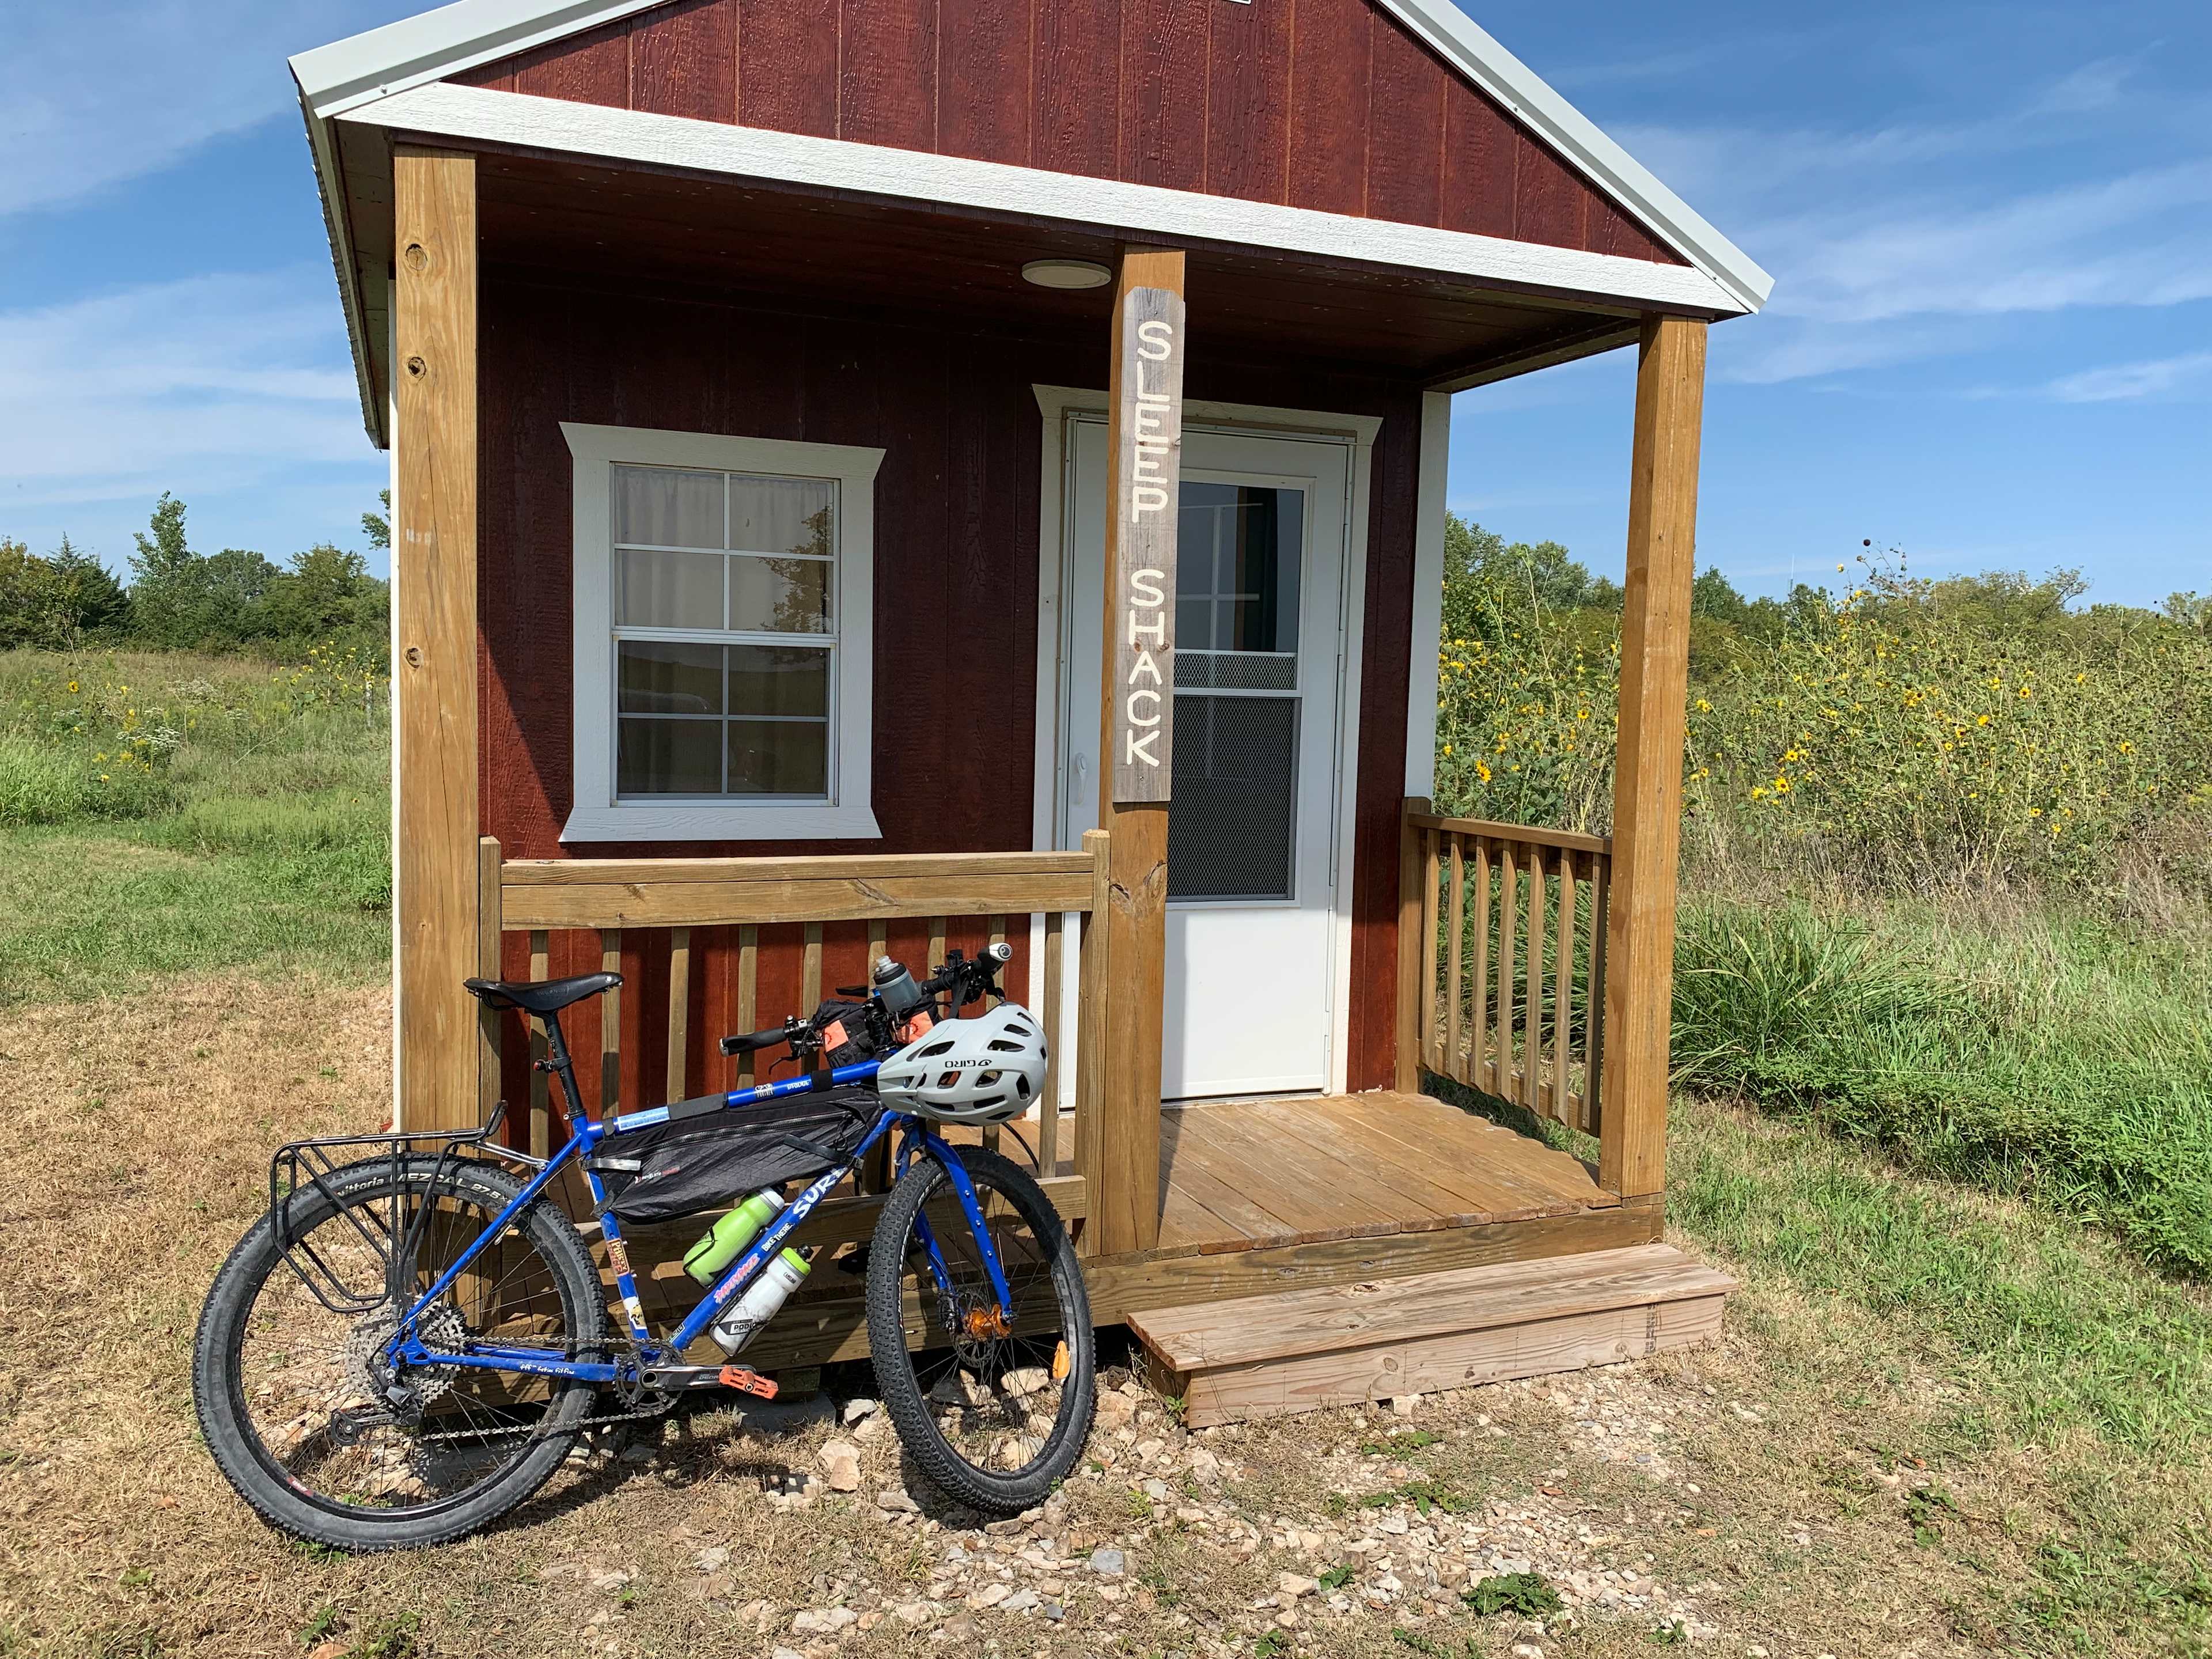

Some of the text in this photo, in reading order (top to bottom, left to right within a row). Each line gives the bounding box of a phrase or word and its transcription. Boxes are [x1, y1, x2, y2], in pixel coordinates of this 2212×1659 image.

[1126, 320, 1173, 767] SLEEP SHACK
[945, 1059, 976, 1068] GIRO
[760, 1236, 777, 1252] BIKE
